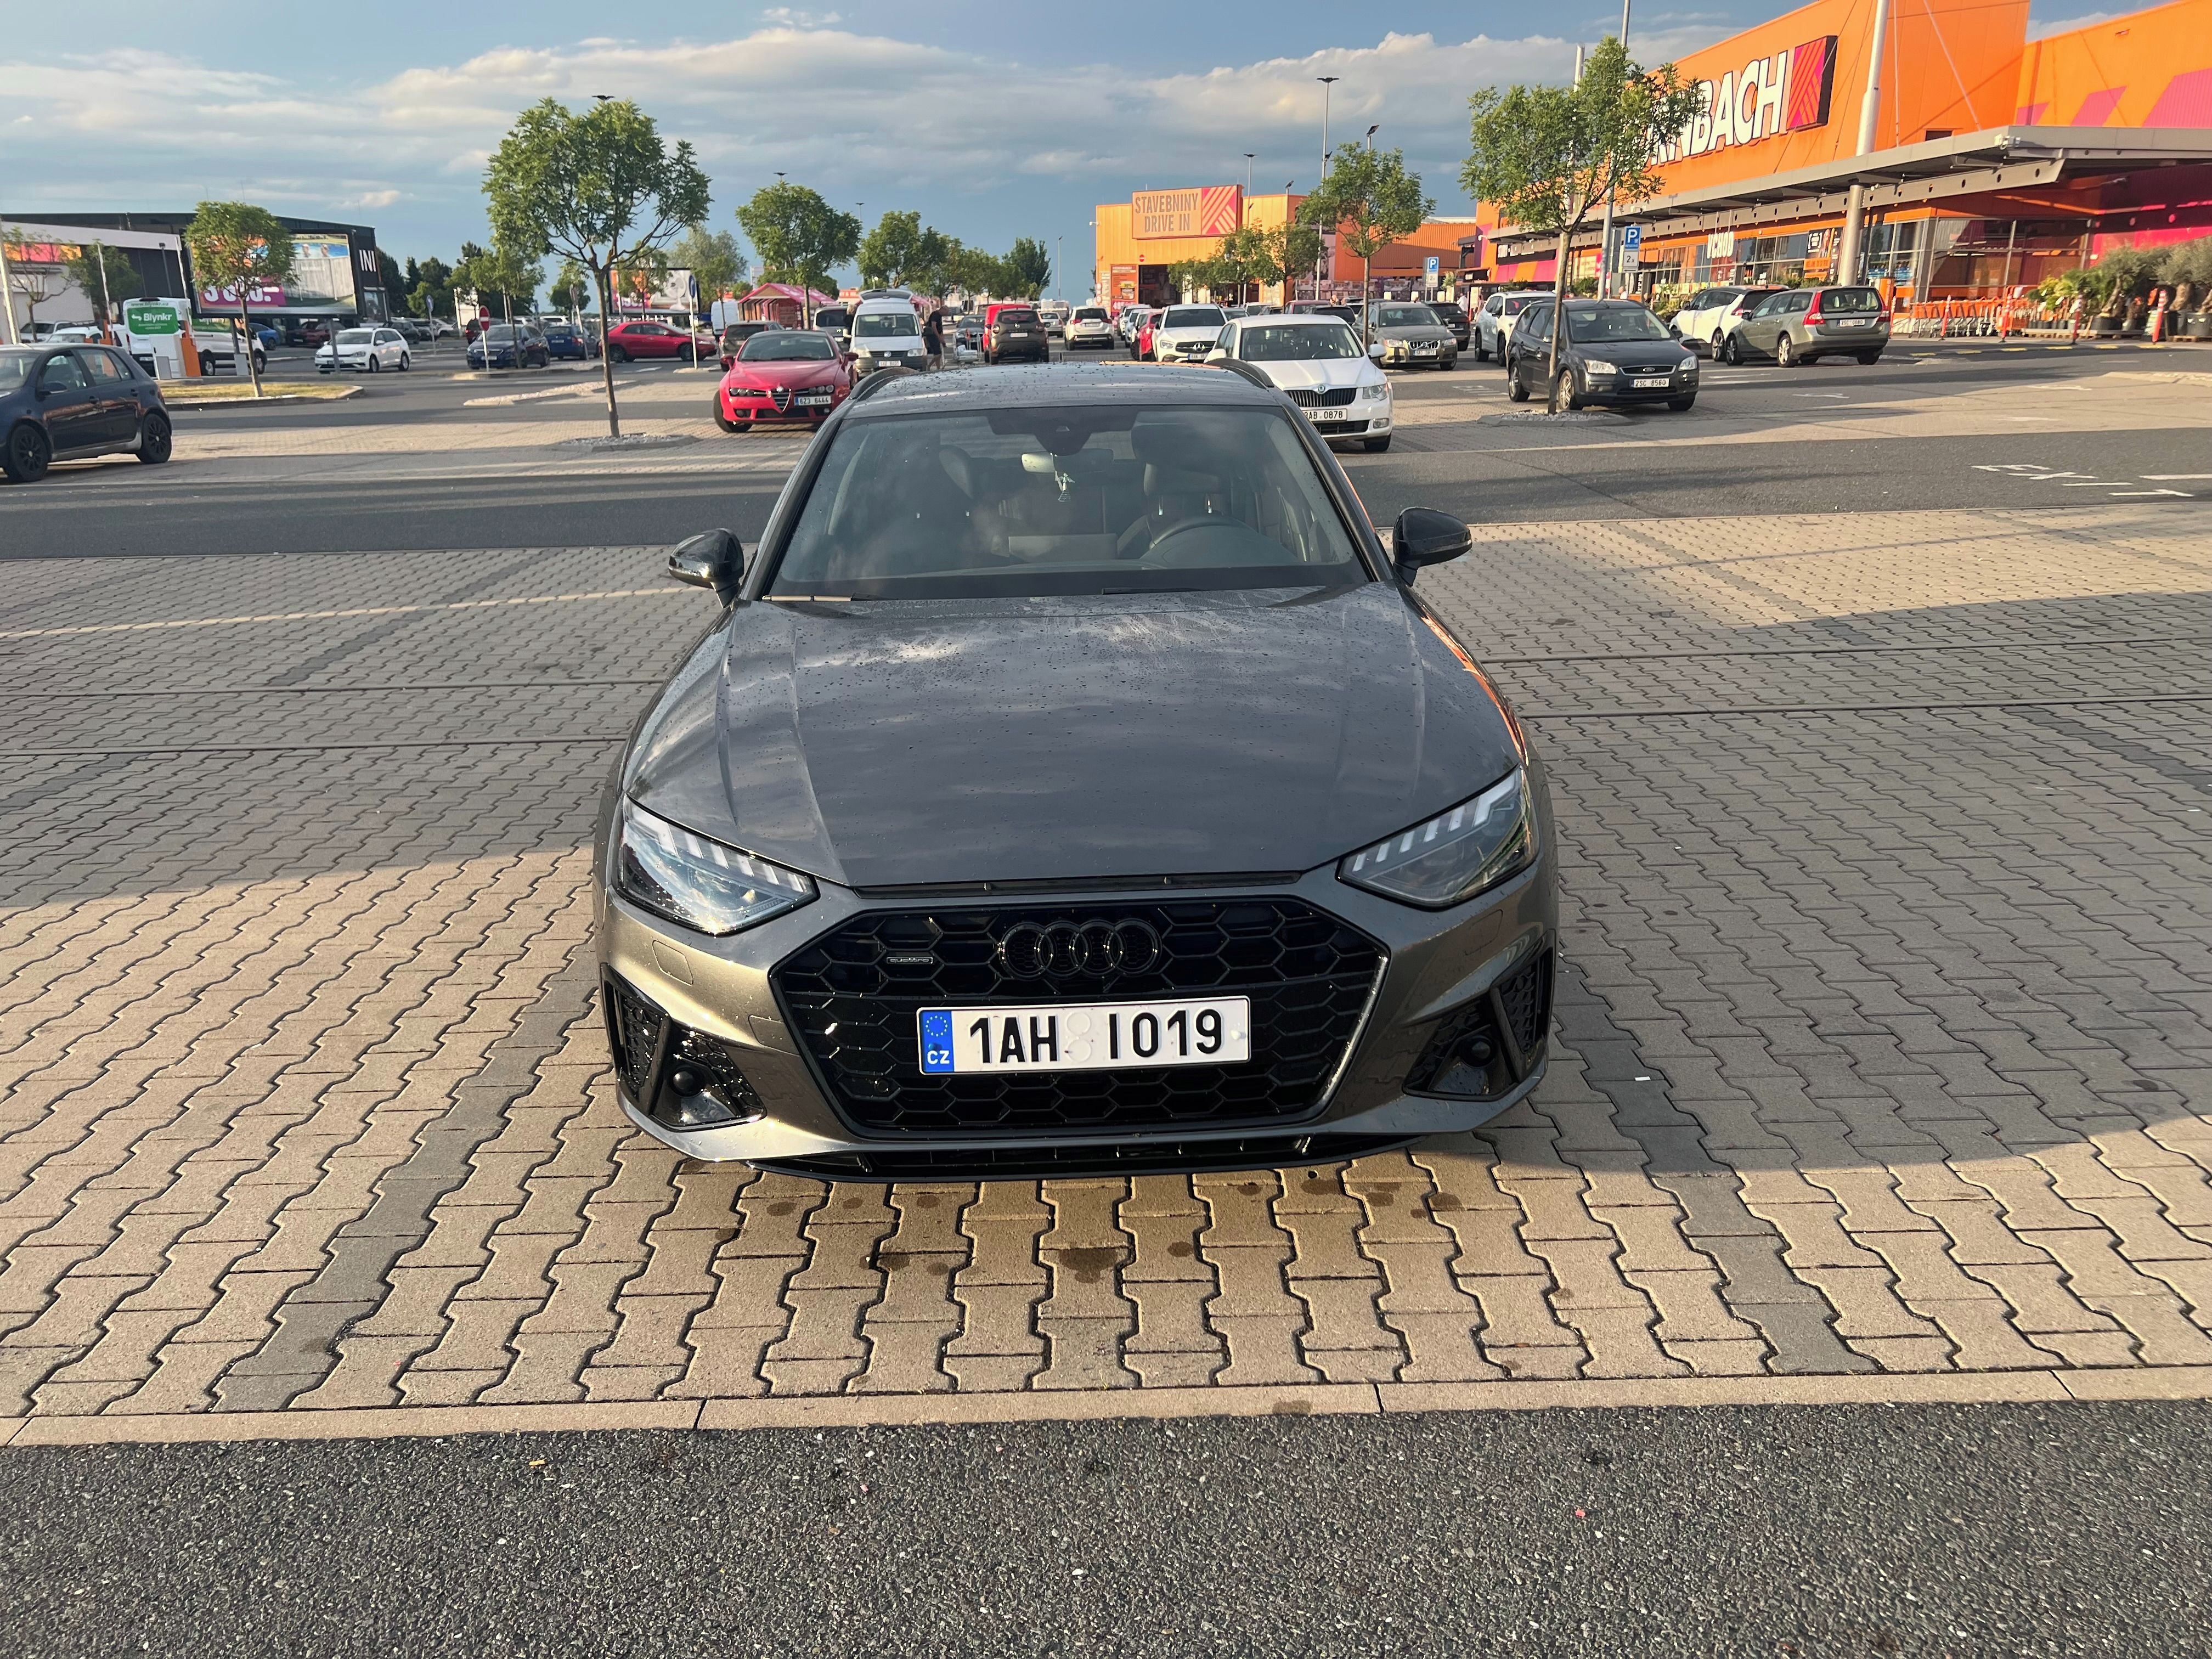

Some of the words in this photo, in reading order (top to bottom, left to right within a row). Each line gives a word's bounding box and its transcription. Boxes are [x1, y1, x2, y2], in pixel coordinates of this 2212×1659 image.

[1135, 193, 1199, 213] STAVEBNINY
[1144, 215, 1174, 233] DRIVE
[1179, 213, 1189, 231] IN
[1627, 229, 1638, 243] P
[1707, 231, 1734, 259] VCHOD
[1430, 259, 1436, 268] P
[143, 313, 172, 323] Blynkr
[969, 1016, 1058, 1064] 1AH
[927, 1050, 950, 1064] CZ
